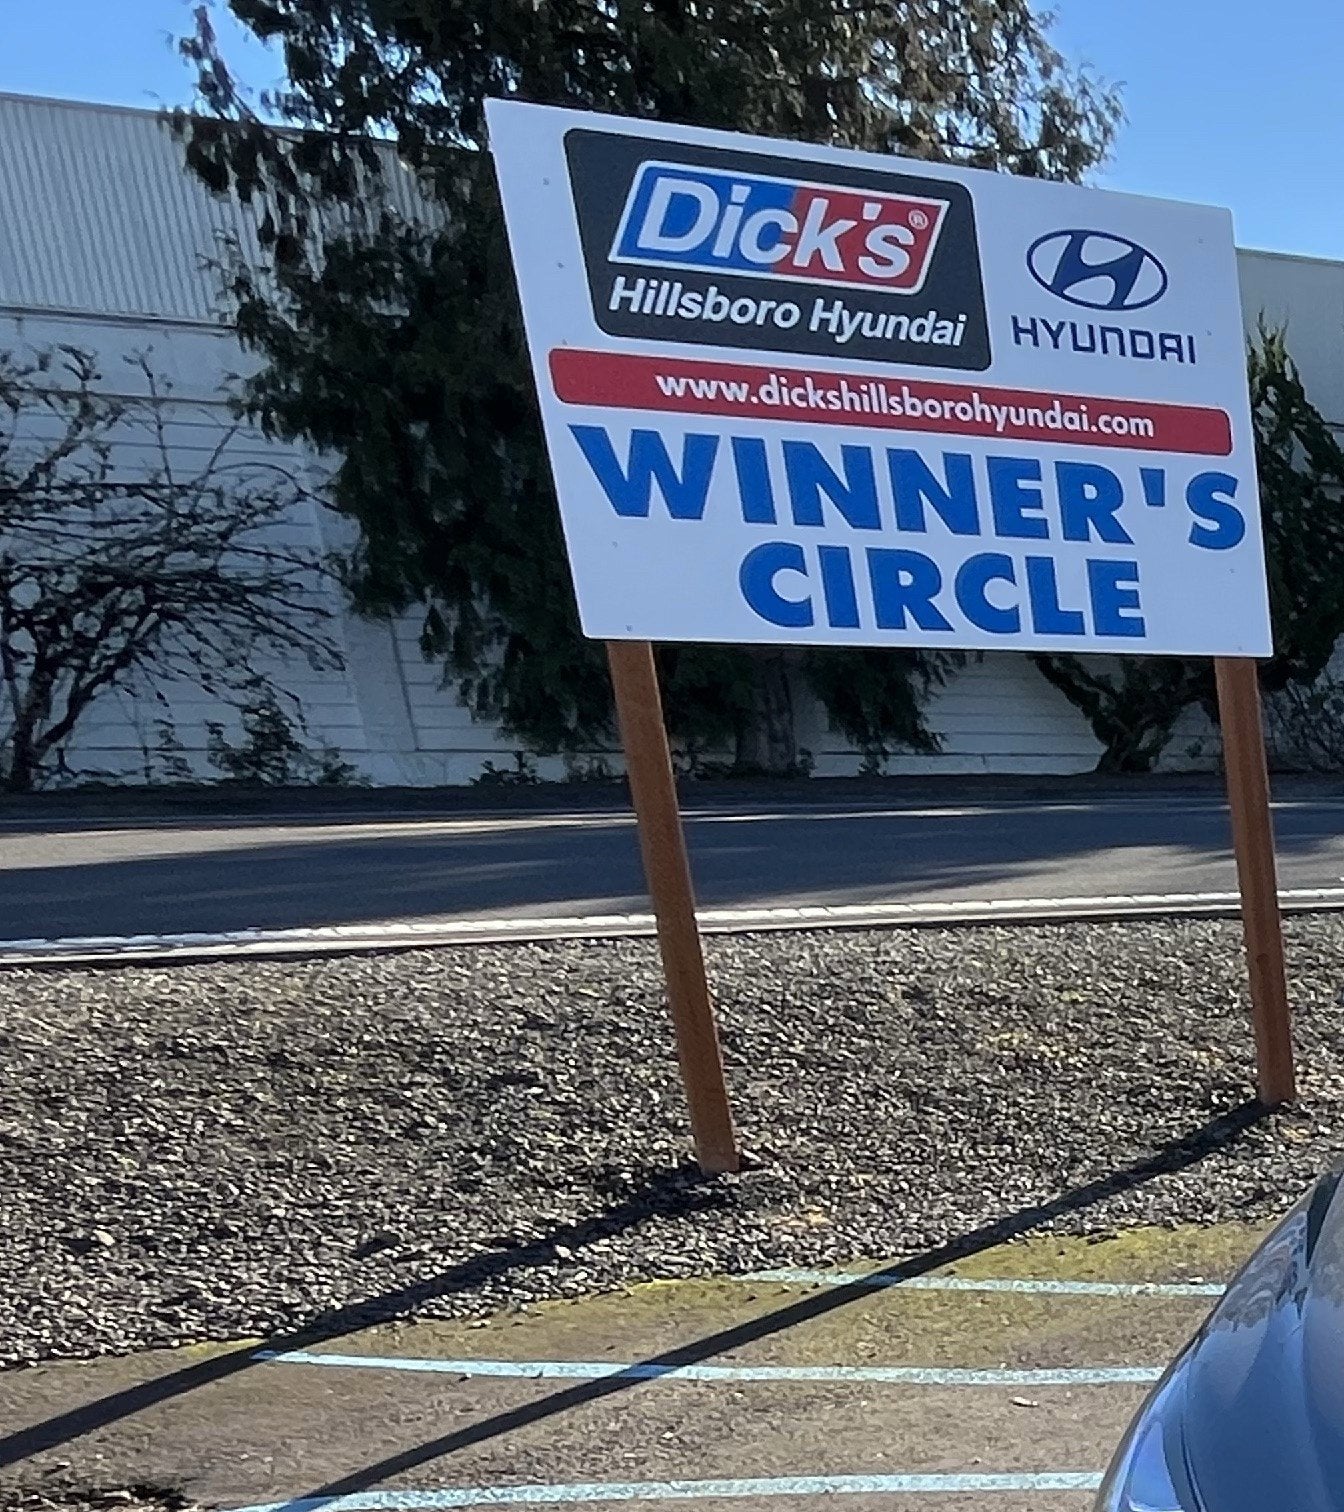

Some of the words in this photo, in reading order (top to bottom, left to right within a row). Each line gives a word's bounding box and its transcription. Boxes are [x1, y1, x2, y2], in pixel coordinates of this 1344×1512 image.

[637, 177, 914, 278] Dick's
[609, 276, 801, 329] Hillsboro
[808, 298, 967, 347] Hyundai
[1010, 314, 1197, 364] HYUNDAI
[655, 371, 1155, 441] www.dickshillsborohyundai.com
[568, 424, 1246, 550] WINNER'S
[738, 541, 1146, 637] CIRCLE
